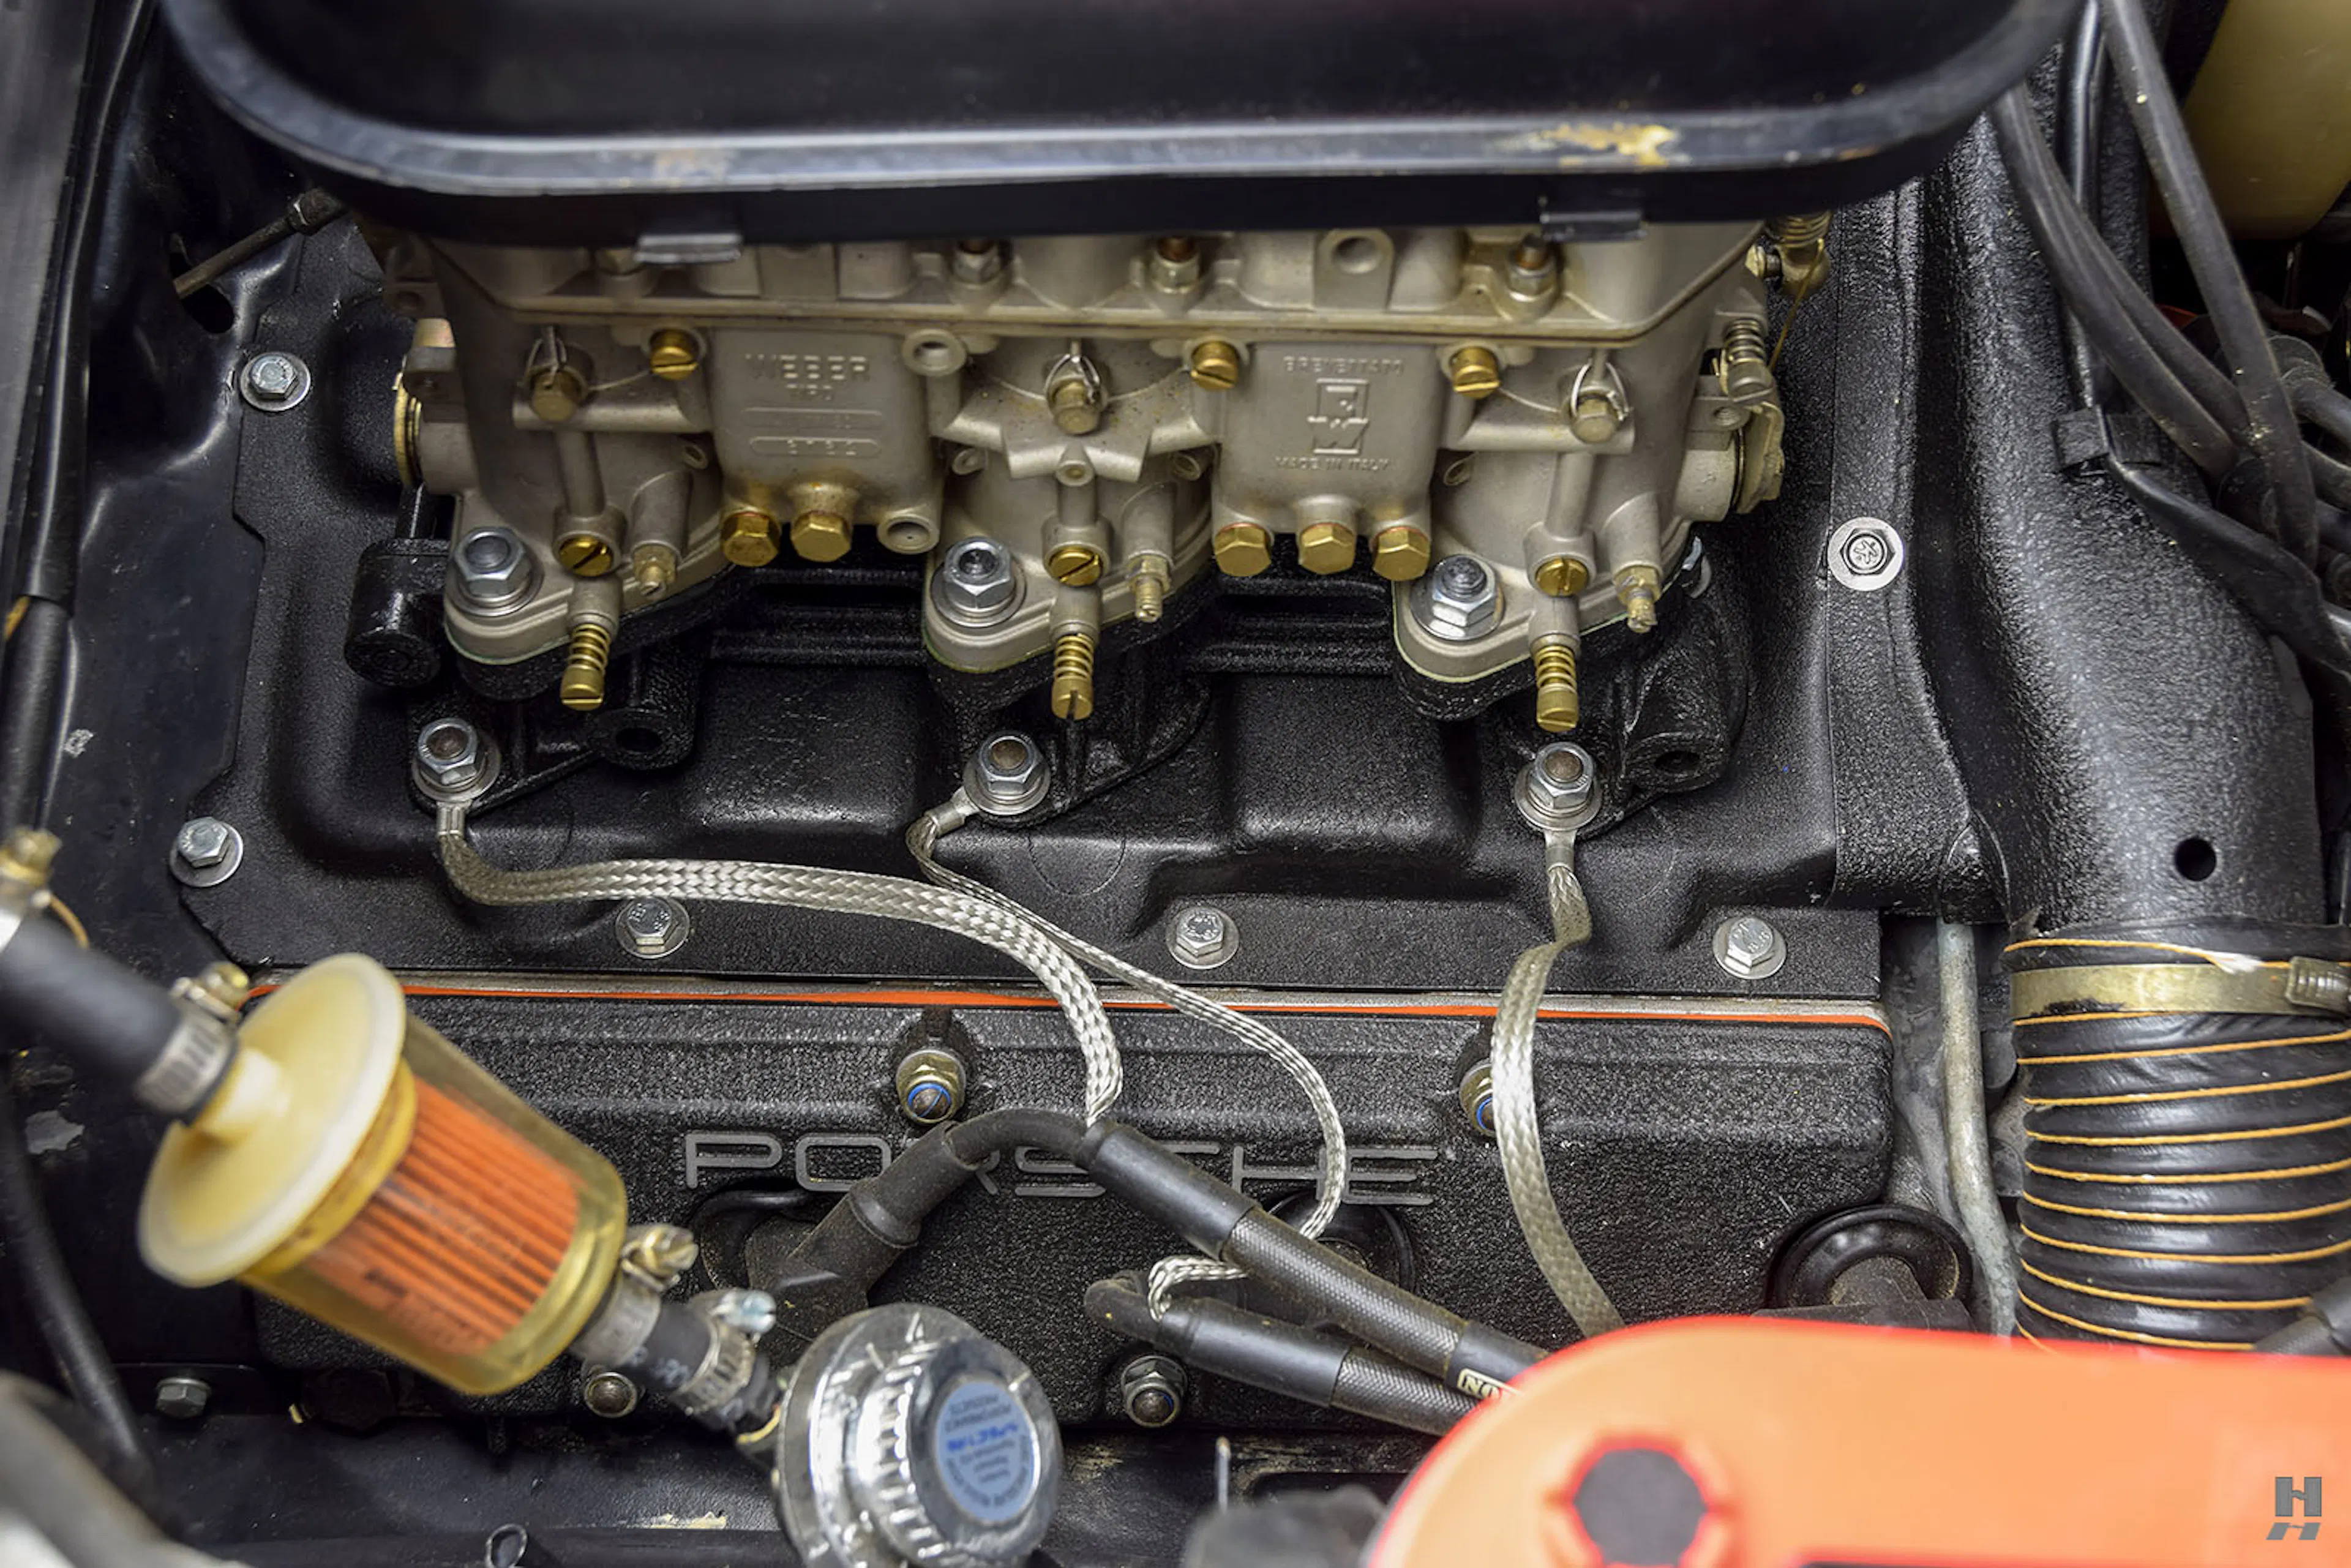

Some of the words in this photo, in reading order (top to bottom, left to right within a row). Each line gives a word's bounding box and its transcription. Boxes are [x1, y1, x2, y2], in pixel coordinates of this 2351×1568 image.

[744, 354, 871, 381] WEBER
[1275, 456, 1319, 470] MADE
[1324, 457, 1343, 471] IN
